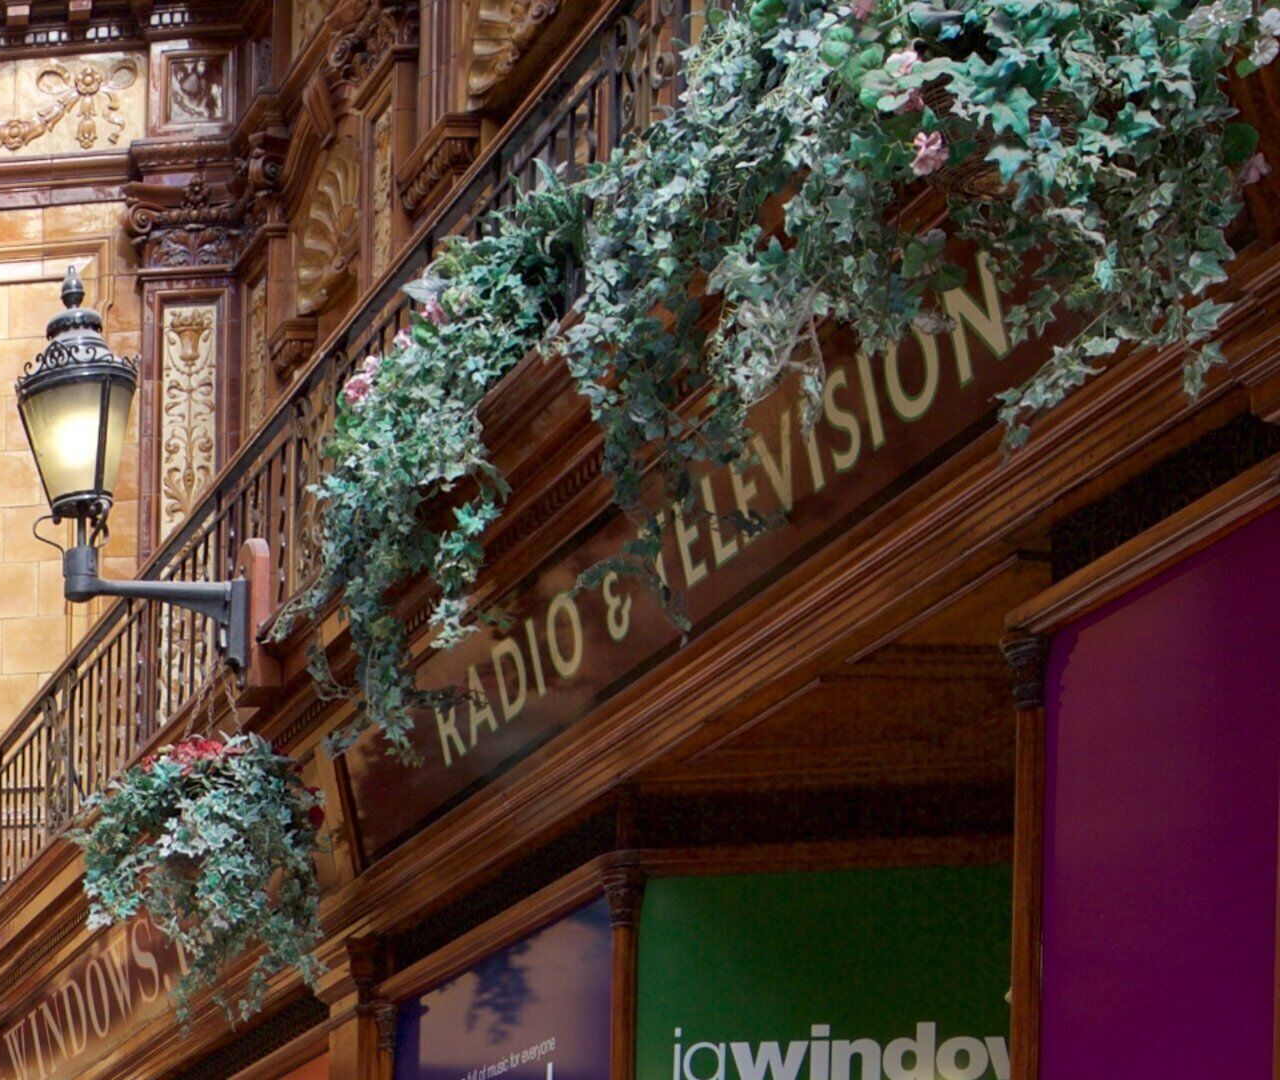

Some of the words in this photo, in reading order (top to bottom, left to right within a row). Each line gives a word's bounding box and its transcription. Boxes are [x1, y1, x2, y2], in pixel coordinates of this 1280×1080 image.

[434, 590, 584, 768] RADIO
[601, 570, 633, 642] &
[487, 1057, 509, 1079] music
[521, 1037, 556, 1064] everyone
